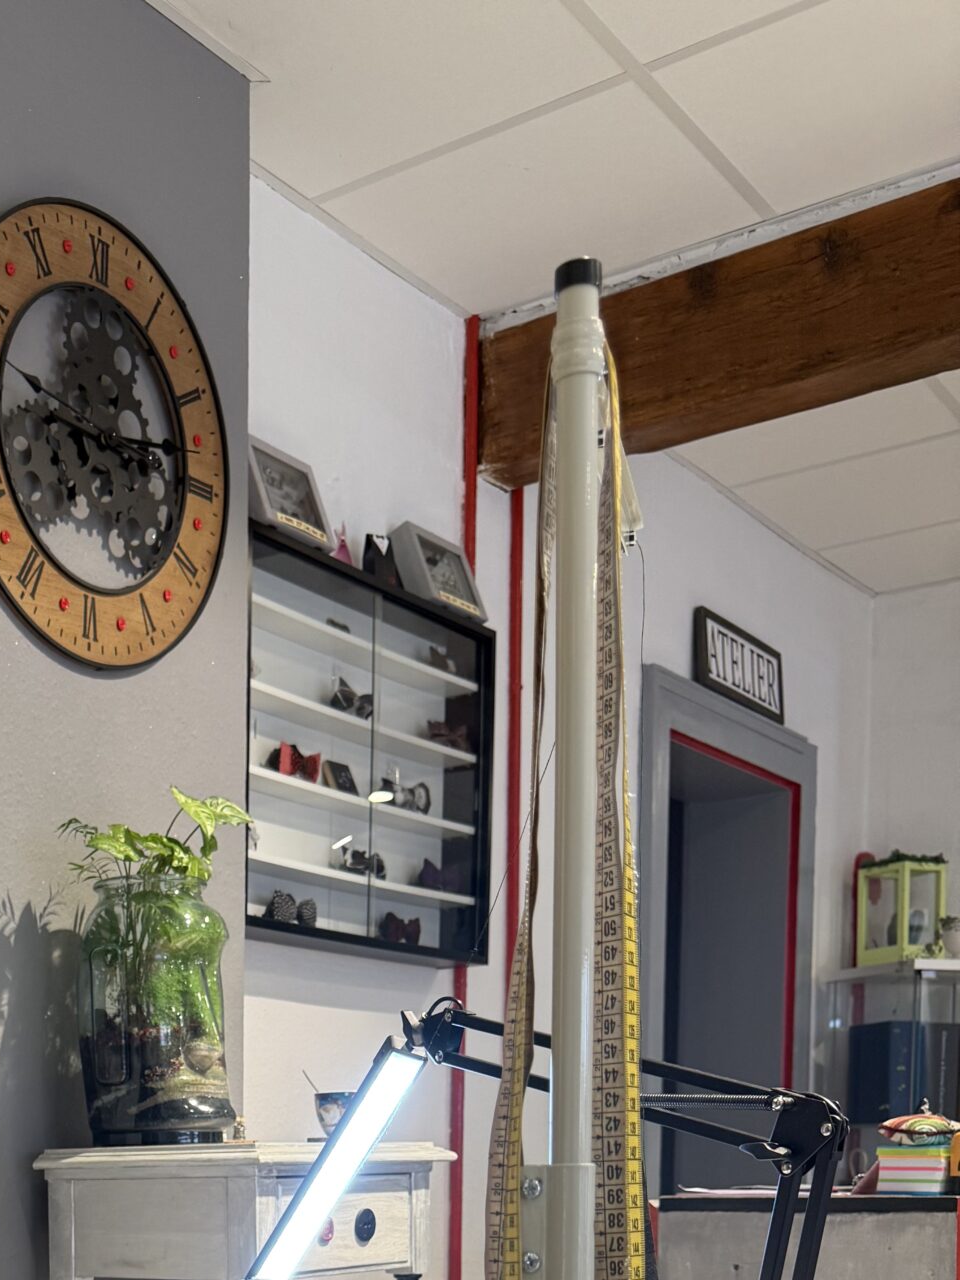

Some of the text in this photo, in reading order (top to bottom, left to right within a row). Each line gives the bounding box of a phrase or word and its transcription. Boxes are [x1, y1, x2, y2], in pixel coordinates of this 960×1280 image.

[24, 227, 52, 279] XI
[89, 234, 110, 288] XII
[178, 387, 202, 408] II
[187, 475, 214, 502] III
[15, 544, 45, 601] VII
[139, 593, 157, 635] V
[709, 625, 779, 710] ATELIER
[604, 871, 614, 888] 52
[605, 895, 615, 912] 51
[604, 920, 616, 937] 50
[604, 945, 617, 961] 49
[604, 969, 617, 986] 48
[604, 994, 617, 1010] 47
[604, 1018, 616, 1035] 46
[604, 1043, 617, 1059] 45
[604, 1067, 619, 1084] 44
[605, 1092, 620, 1108] 43
[605, 1116, 620, 1133] 42
[607, 1140, 621, 1156] 41
[607, 1165, 623, 1180] 40
[607, 1189, 624, 1205] 39
[608, 1213, 624, 1229] 38
[609, 1236, 624, 1252] 37
[610, 1261, 624, 1276] 36
